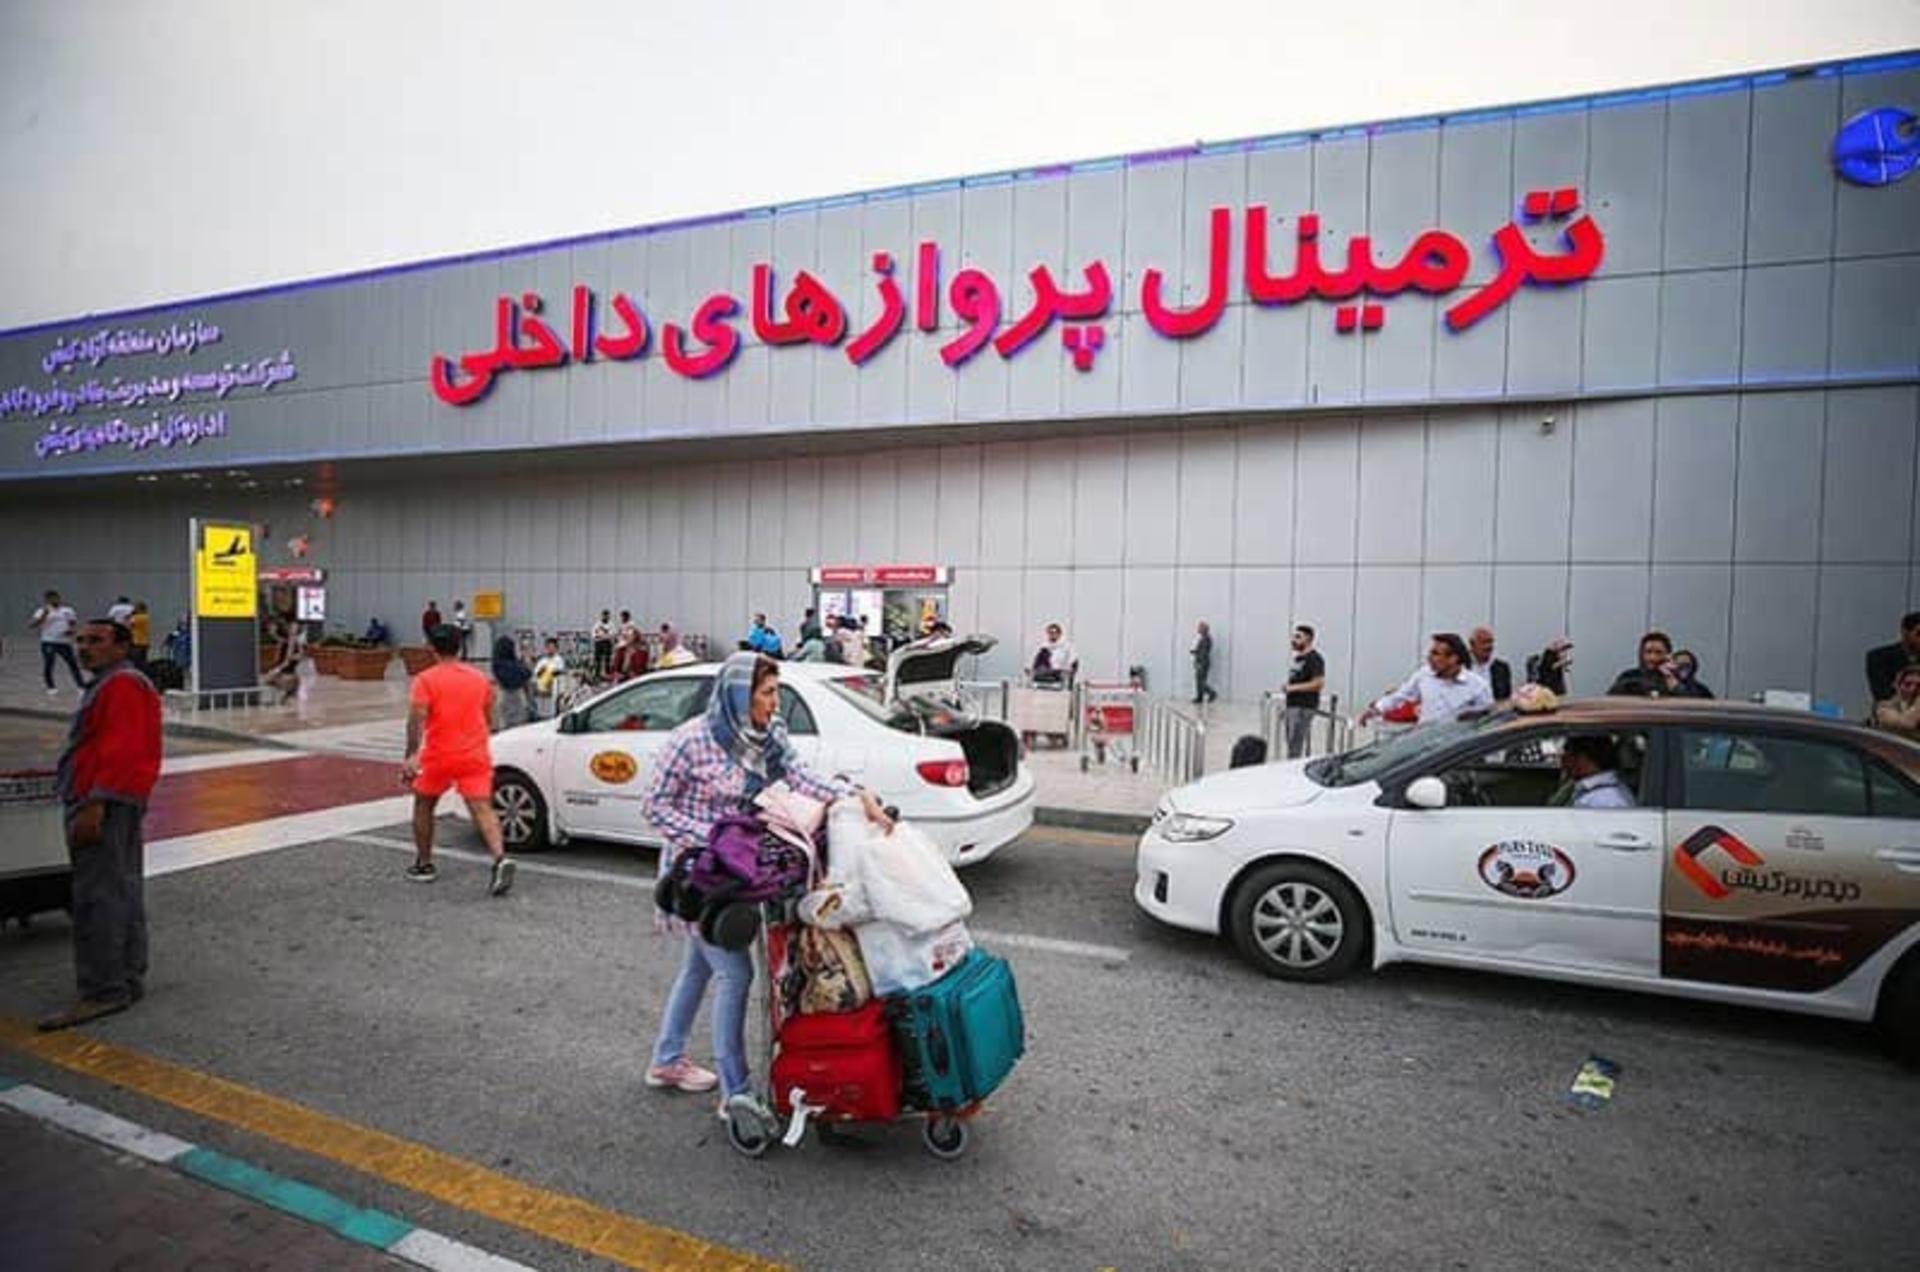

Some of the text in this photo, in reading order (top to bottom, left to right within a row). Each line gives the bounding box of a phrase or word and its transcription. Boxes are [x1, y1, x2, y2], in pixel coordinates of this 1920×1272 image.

[431, 187, 1605, 405] ترمینال پروازهای داخلی
[42, 320, 221, 373] سازمان منطقه آزاد کیش
[235, 349, 296, 388] شرکت
[184, 364, 235, 397] توسعه
